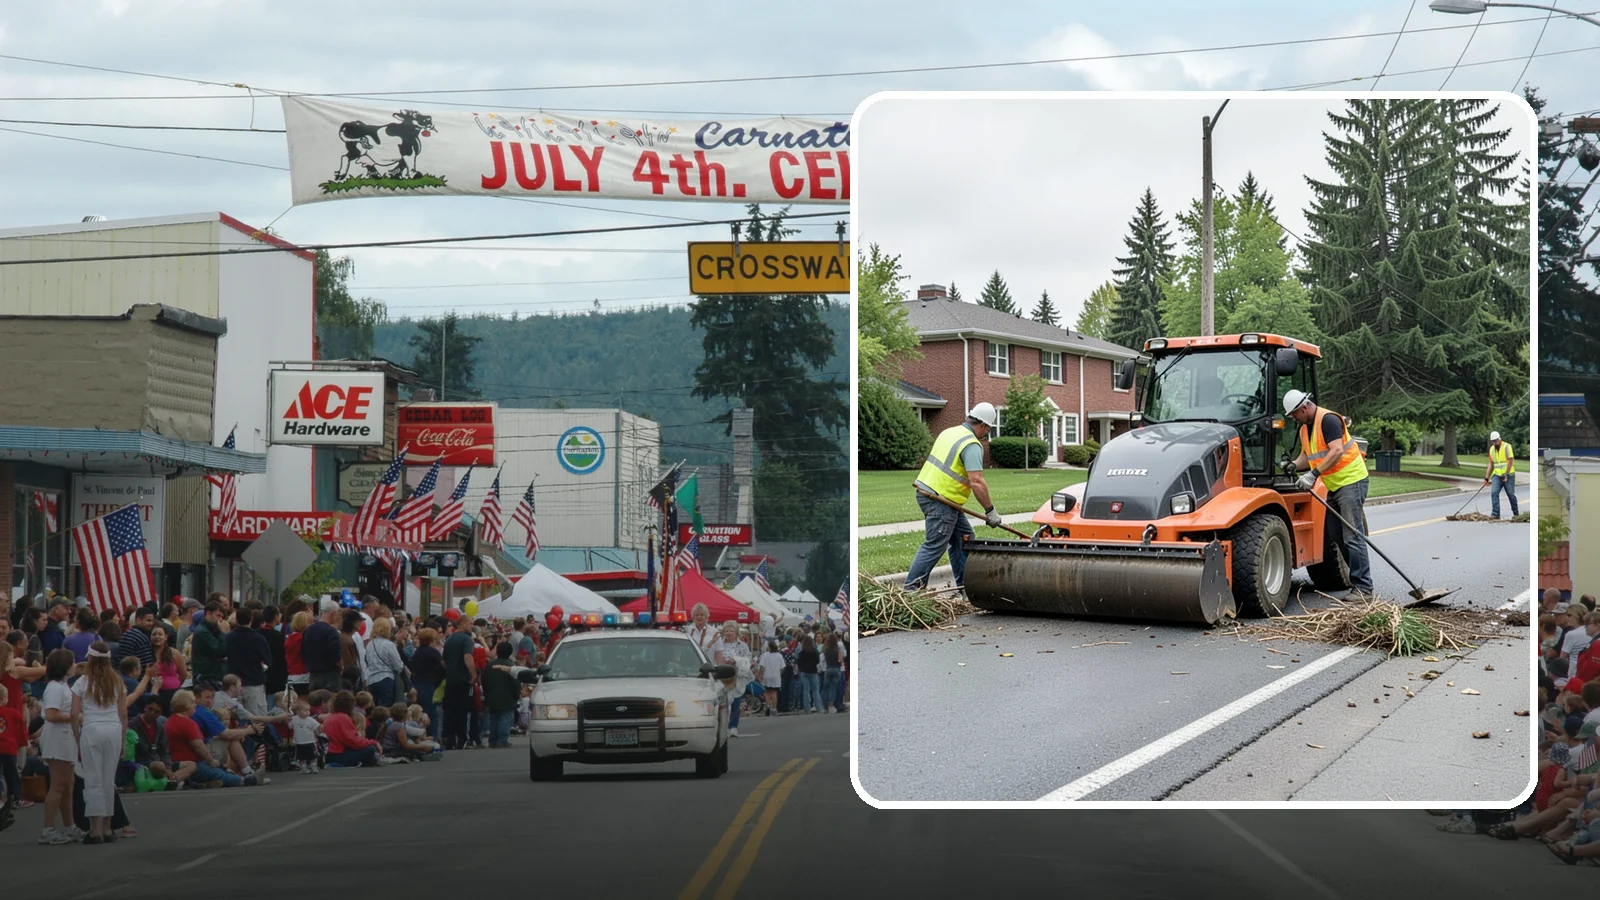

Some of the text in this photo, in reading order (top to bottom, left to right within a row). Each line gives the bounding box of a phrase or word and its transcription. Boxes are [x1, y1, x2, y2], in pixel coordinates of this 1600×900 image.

[695, 121, 850, 150] Carnat
[481, 141, 605, 192] JULY
[633, 150, 746, 197] 4th.
[697, 254, 850, 280] CROSSWA
[283, 380, 373, 420] ACE
[406, 409, 452, 422] CEDAR
[284, 421, 370, 436] Hardware
[416, 428, 477, 447] Coca-Cola
[83, 484, 155, 495] St. Vincent de Paul
[688, 526, 741, 535] CRNATION
[699, 535, 730, 543] GLASS
